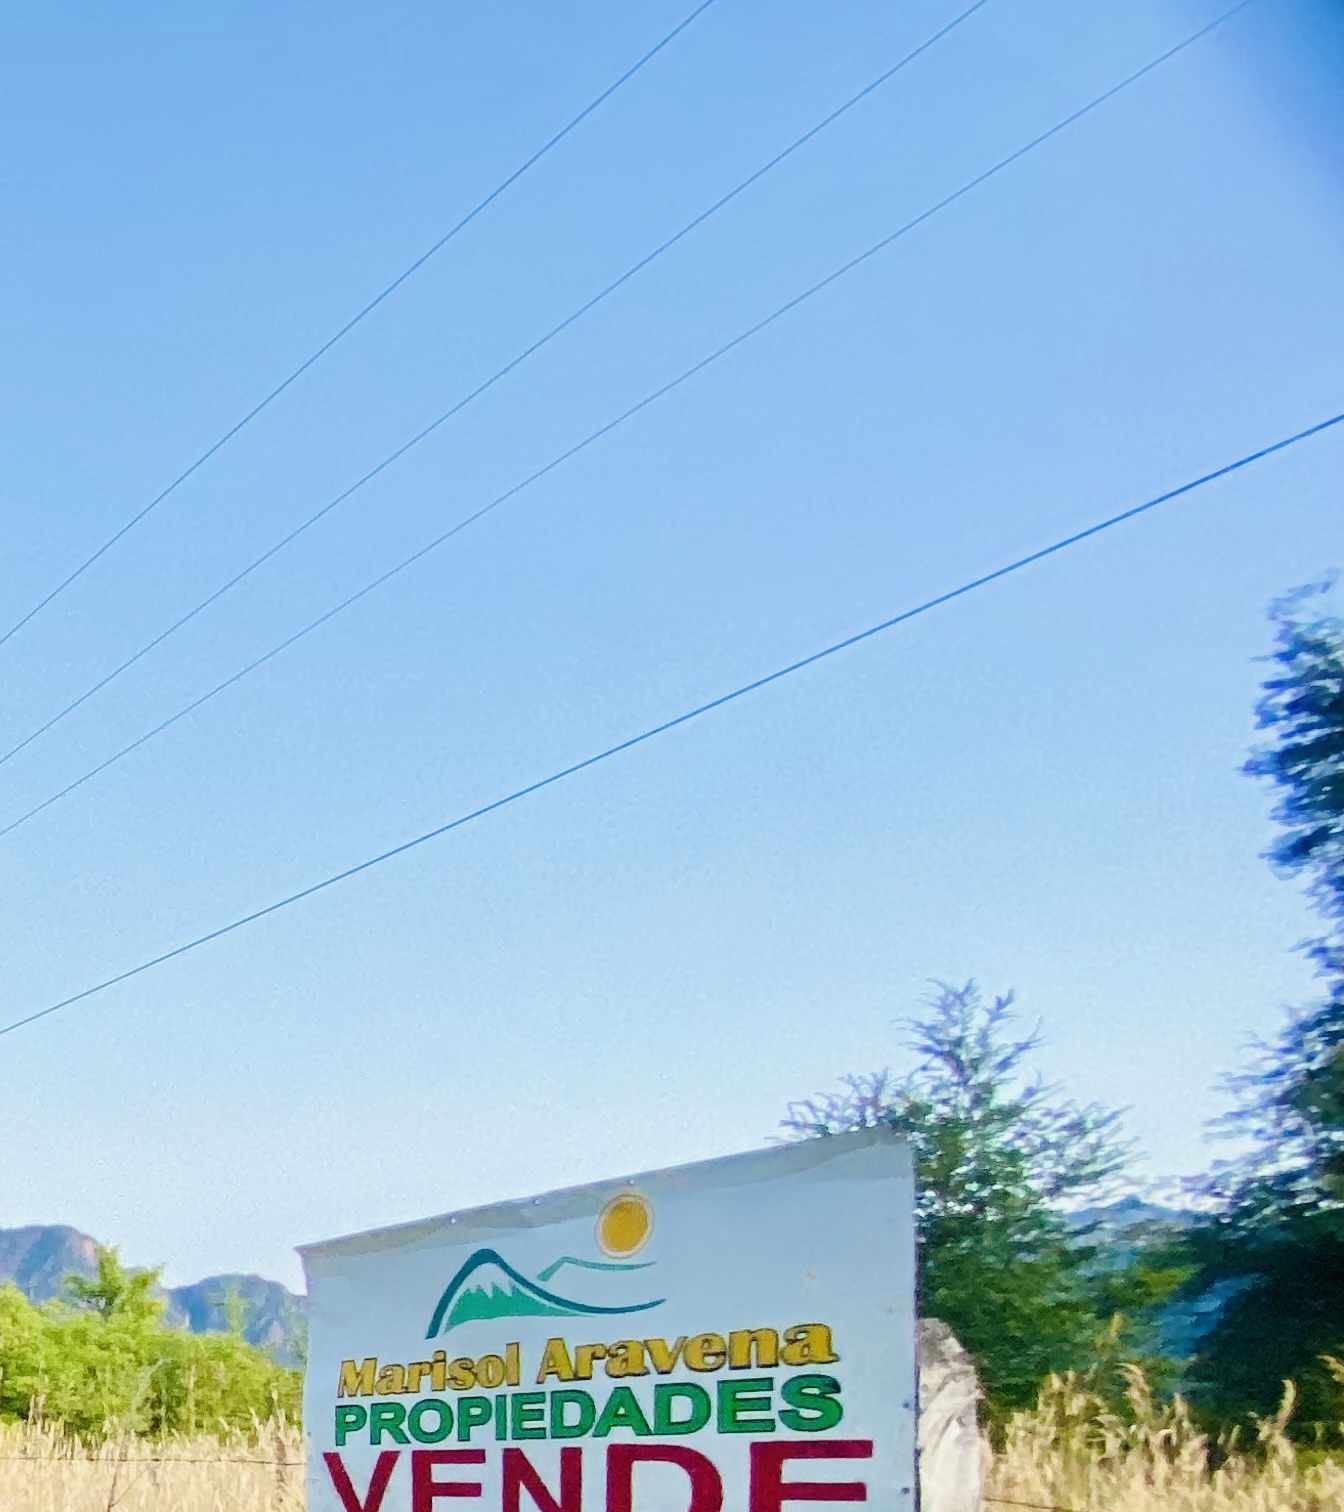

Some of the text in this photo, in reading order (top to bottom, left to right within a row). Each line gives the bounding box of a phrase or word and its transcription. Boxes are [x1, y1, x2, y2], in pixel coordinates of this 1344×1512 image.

[337, 1322, 840, 1398] Marisol Aravena
[334, 1373, 844, 1447] PROPIEDADES
